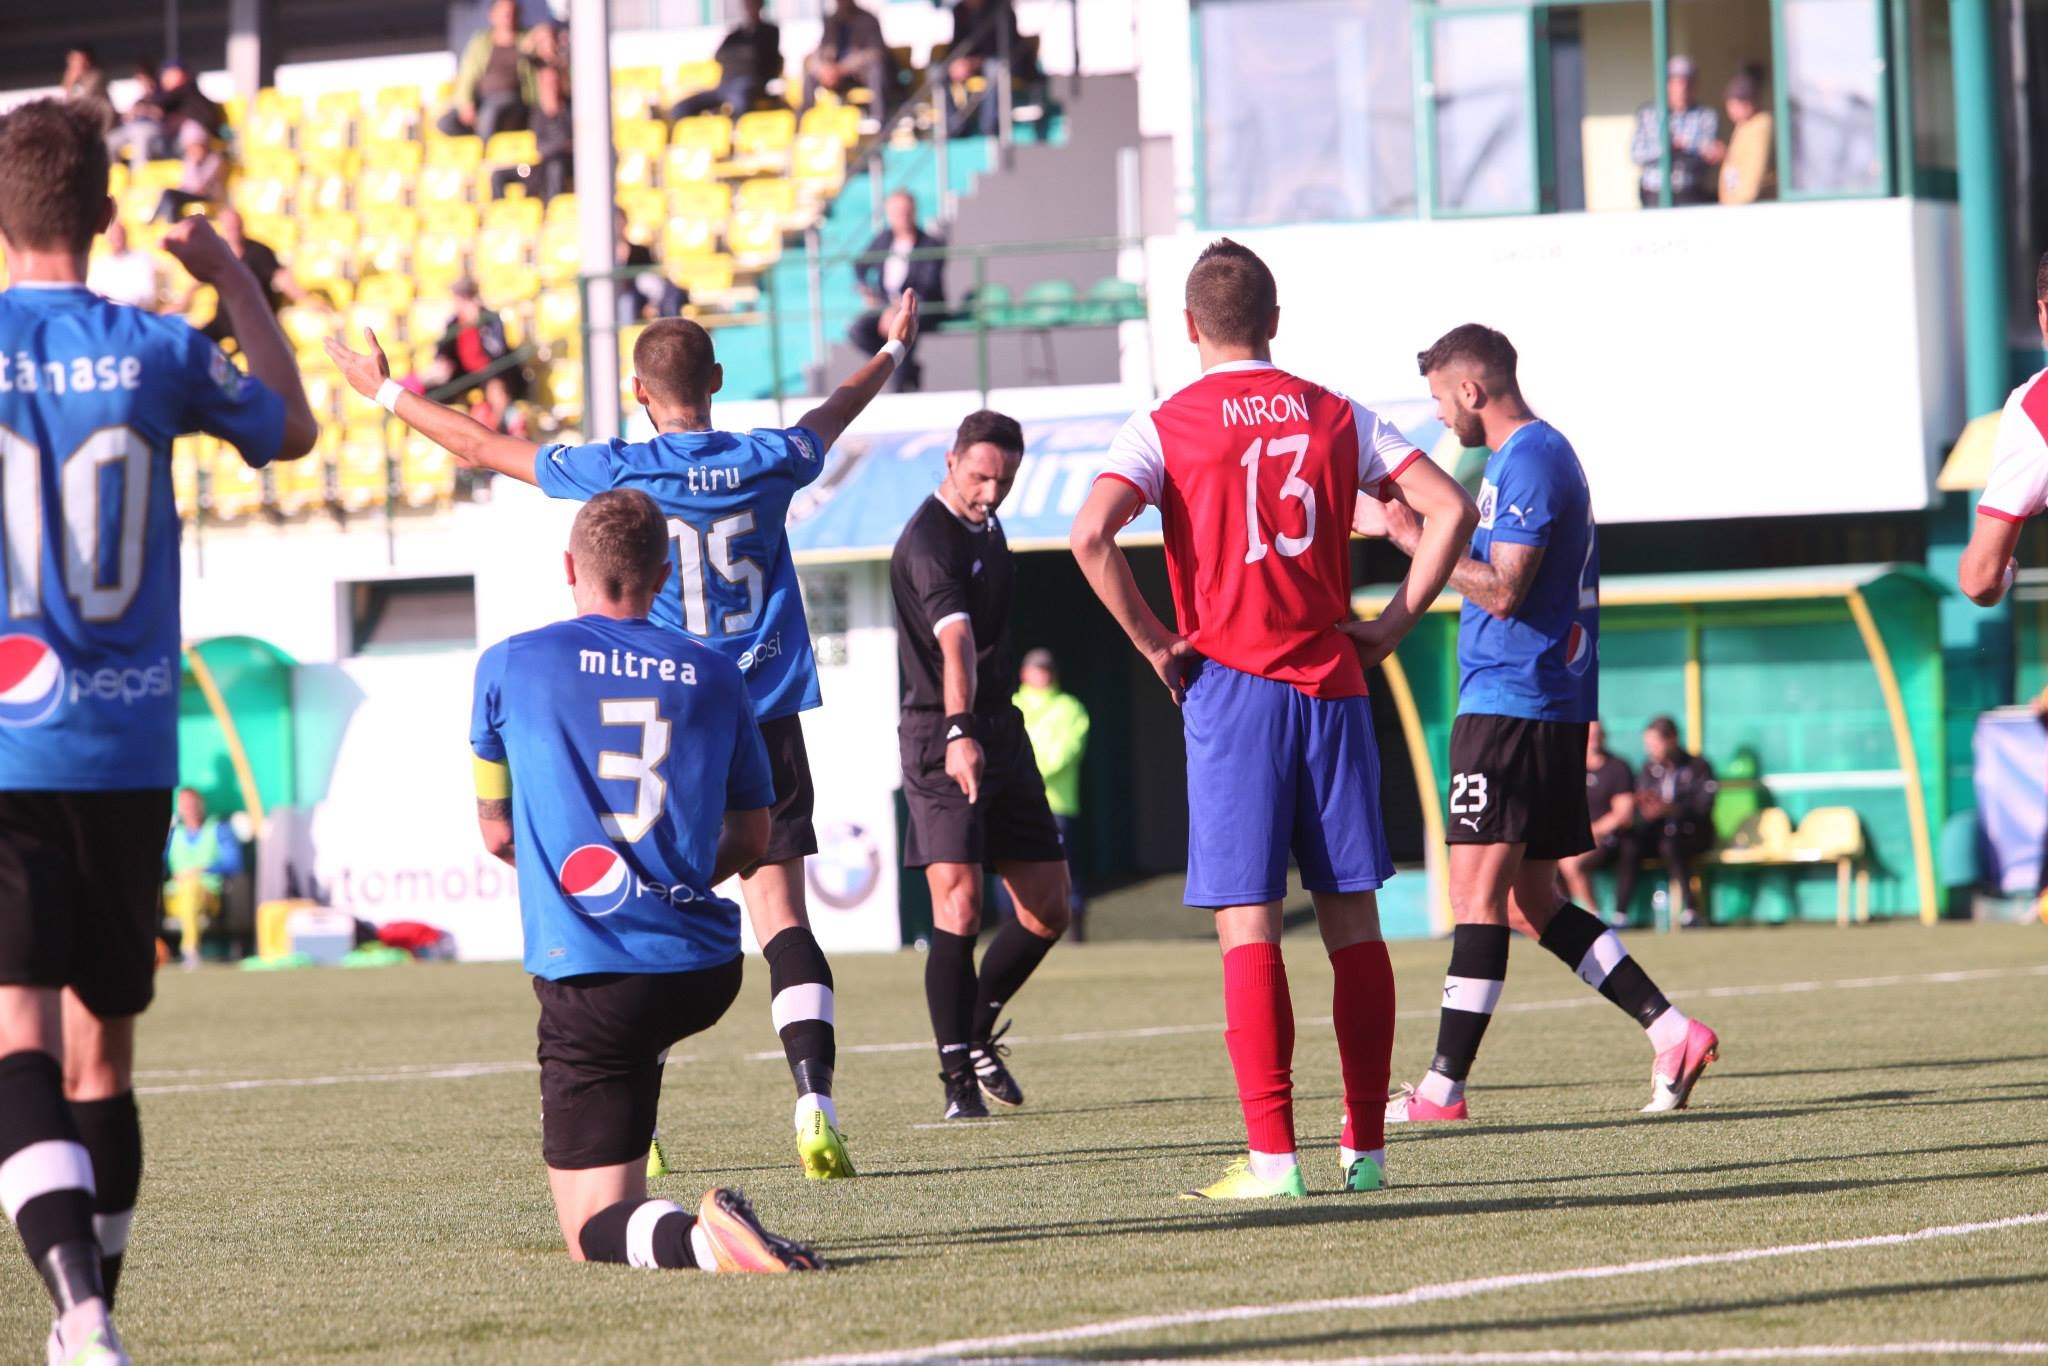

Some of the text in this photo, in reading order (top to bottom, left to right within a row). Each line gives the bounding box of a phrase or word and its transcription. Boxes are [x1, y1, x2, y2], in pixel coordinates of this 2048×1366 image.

[1222, 393, 1310, 428] MIRON
[0, 423, 151, 622] 10
[1240, 433, 1317, 565] 13
[666, 508, 765, 638] 15
[579, 649, 697, 685] mitrea
[736, 631, 782, 671] epsi
[70, 656, 172, 705] pepsi
[598, 697, 672, 843] 3
[1450, 772, 1488, 814] 23
